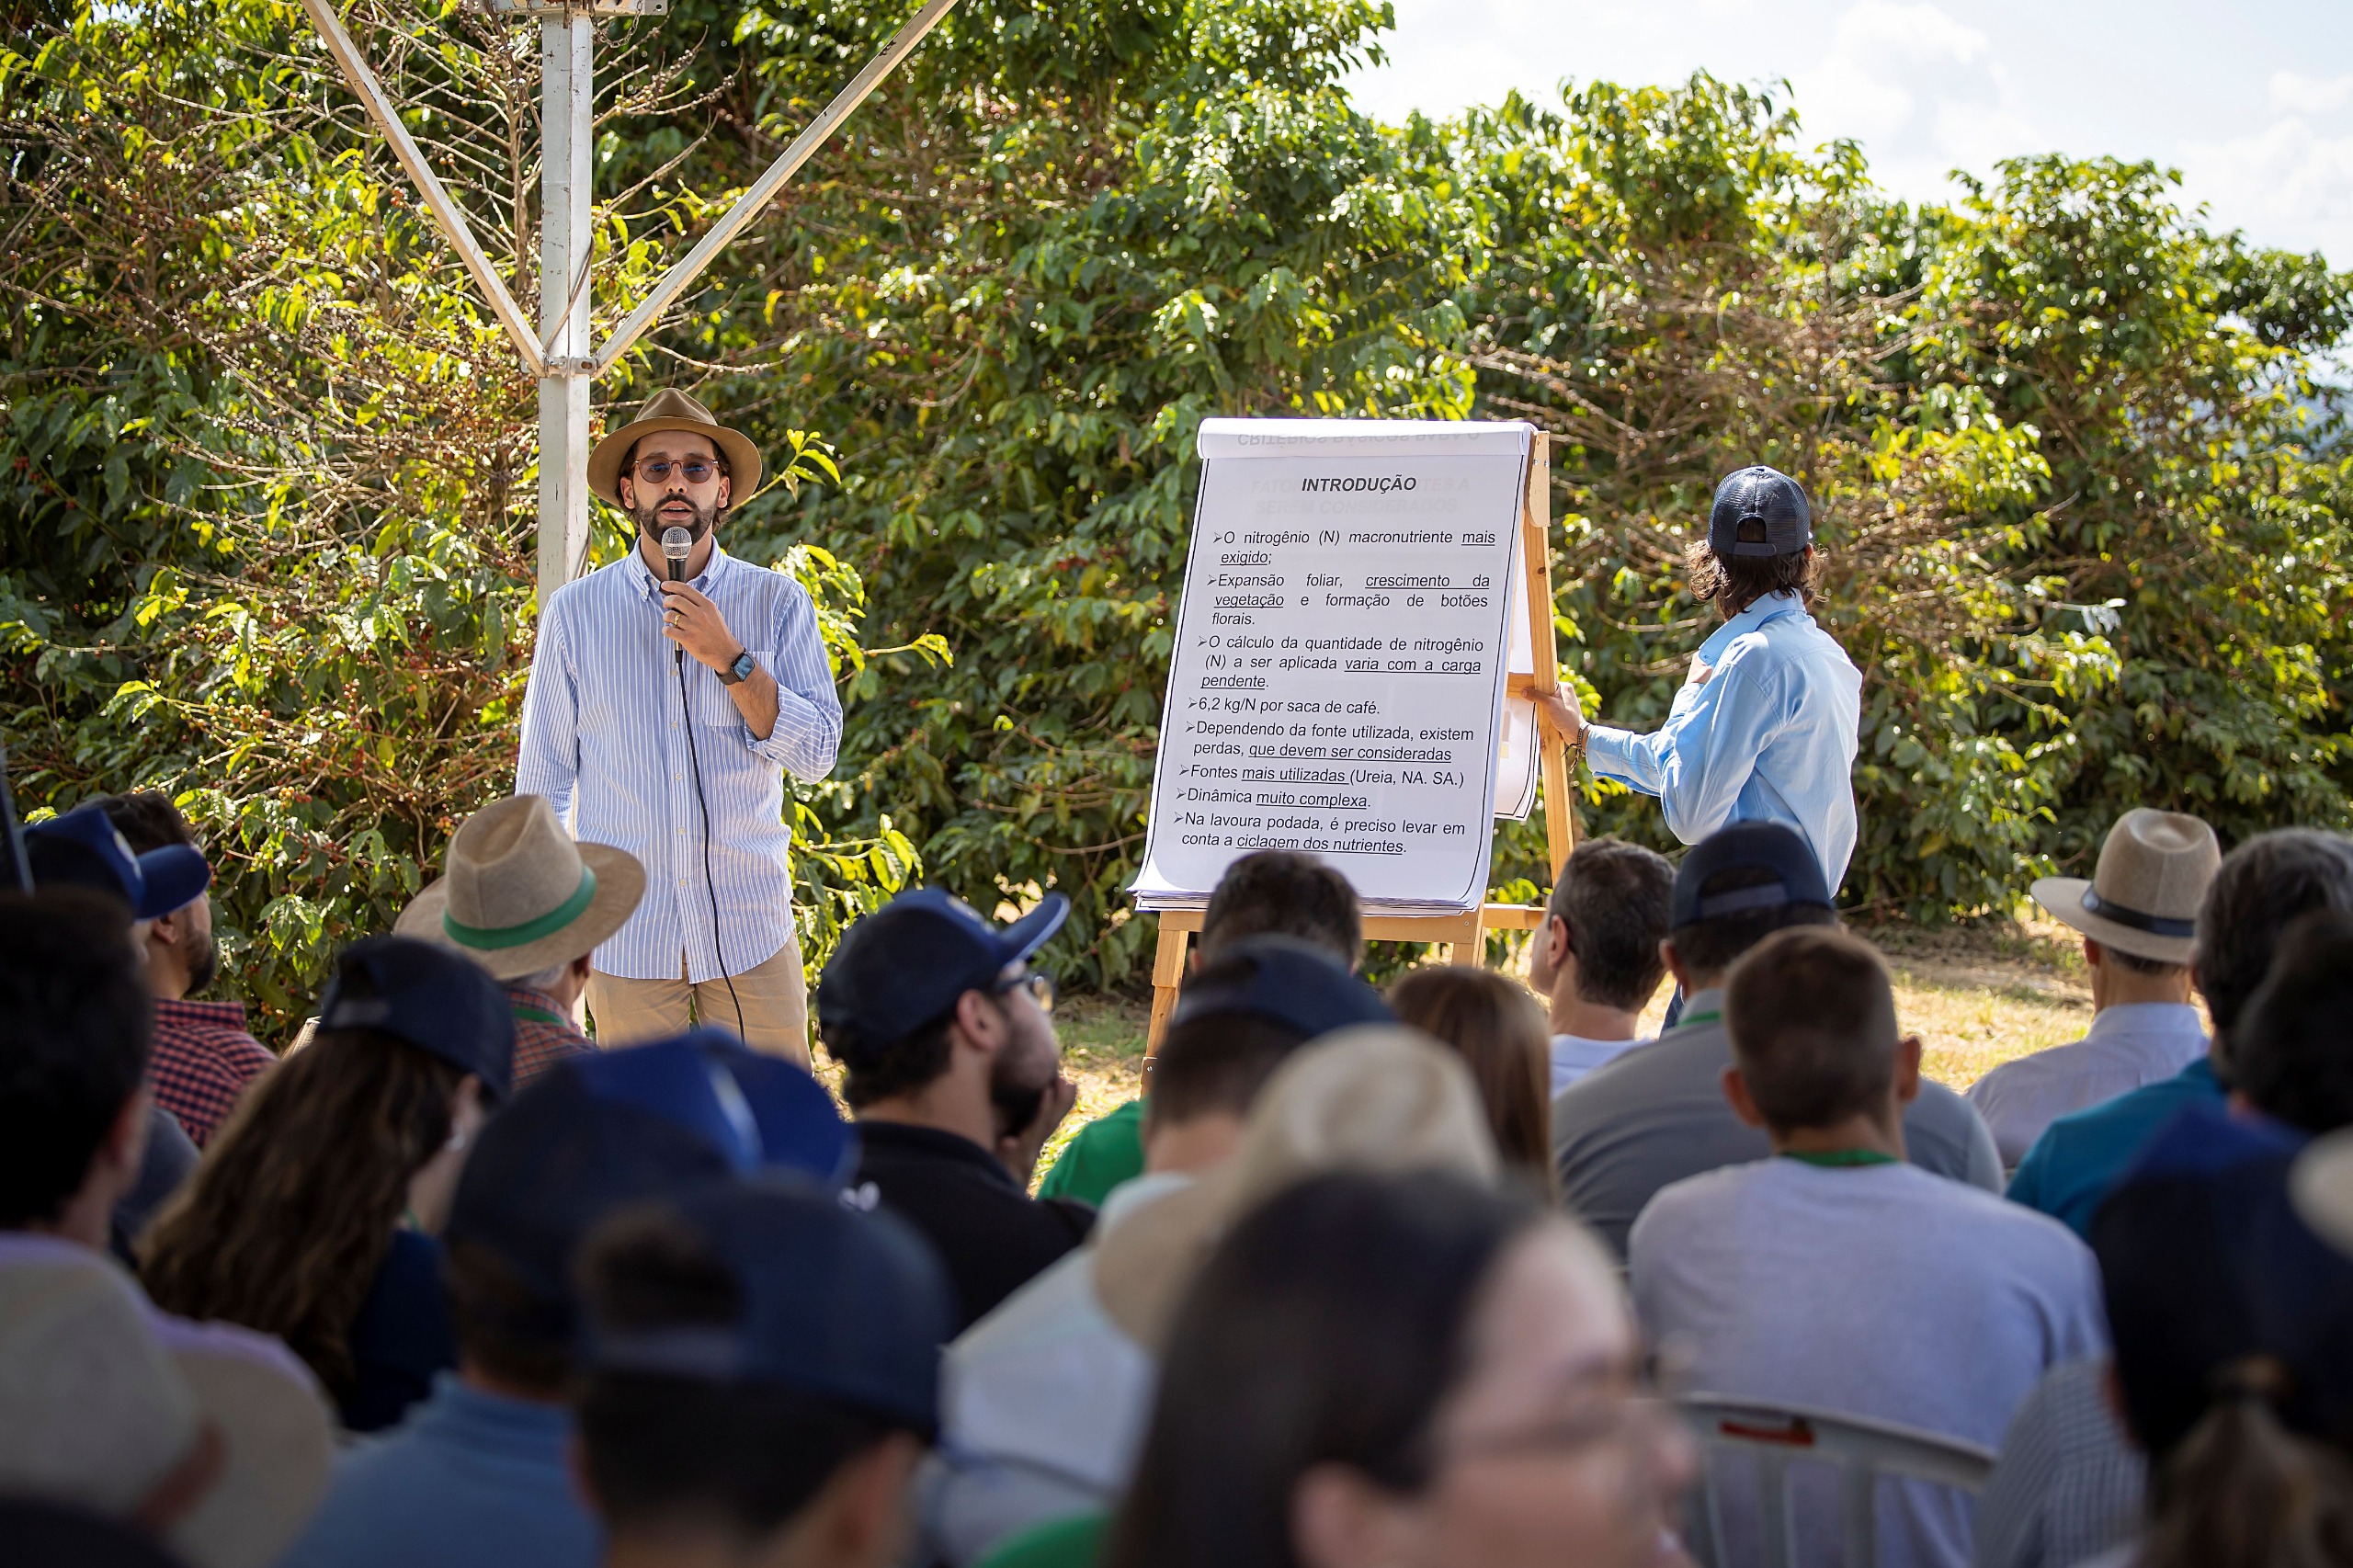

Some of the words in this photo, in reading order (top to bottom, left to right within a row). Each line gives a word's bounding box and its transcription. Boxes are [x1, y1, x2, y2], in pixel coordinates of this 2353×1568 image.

[1302, 474, 1417, 494] INTRODUÇÃO
[1224, 531, 1235, 544] O
[1245, 531, 1310, 547] nitrogênio
[1319, 530, 1340, 547] (N)
[1349, 530, 1453, 543] macronutriente
[1461, 530, 1495, 547] mais
[1220, 551, 1272, 567] exigido;
[1219, 574, 1285, 589] Expansão
[1307, 574, 1343, 589] foliar,
[1365, 574, 1450, 590] crescimento
[1472, 574, 1490, 590] da
[1214, 594, 1285, 609] vegetação
[1301, 597, 1309, 607] e
[1326, 594, 1391, 610] formação
[1407, 594, 1425, 608] de
[1441, 594, 1488, 608] botões
[1212, 612, 1255, 625] florais.
[1210, 636, 1221, 648] O
[1227, 636, 1275, 649] cálculo
[1281, 636, 1298, 649] da
[1305, 637, 1382, 653] quantidade
[1390, 638, 1407, 651] de
[1415, 638, 1483, 654] nitrogênio
[1206, 654, 1226, 671] (N)
[1234, 658, 1243, 668] a
[1250, 658, 1273, 668] ser
[1279, 656, 1337, 672] aplicada
[1344, 657, 1380, 674] varia
[1386, 661, 1417, 674] com
[1424, 661, 1434, 673] a
[1440, 662, 1482, 676] carga
[1200, 675, 1269, 691] pendente.
[1199, 698, 1221, 712] 6,2
[1224, 698, 1256, 714] kg/N
[1260, 702, 1283, 715] por
[1287, 702, 1321, 713] saca
[1325, 700, 1342, 713] de
[1347, 701, 1380, 715] café.
[1197, 722, 1285, 738] Dependendo
[1290, 723, 1307, 737] da
[1313, 724, 1347, 738] fonte
[1353, 725, 1414, 742] utilizada,
[1420, 727, 1474, 741] existem
[1194, 742, 1245, 757] perdas,
[1248, 745, 1276, 759] que
[1279, 744, 1327, 760] devem
[1330, 748, 1354, 760] ser
[1357, 746, 1452, 764] consideradas
[1191, 765, 1238, 778] Fontes
[1242, 767, 1277, 783] mais
[1279, 767, 1350, 786] utilizadas
[1349, 769, 1396, 786] (Ureia,
[1402, 771, 1427, 785] NA.
[1433, 772, 1464, 790] SA.)
[1188, 788, 1252, 803] Dinâmica
[1256, 791, 1296, 808] muito
[1299, 793, 1371, 811] complexa.
[1186, 812, 1205, 825] Na
[1211, 813, 1262, 828] lavoura
[1267, 816, 1324, 832] podada,
[1330, 817, 1339, 831] é
[1345, 819, 1396, 835] preciso
[1403, 820, 1438, 835] levar
[1443, 824, 1465, 835] em
[1182, 834, 1220, 846] conta
[1224, 836, 1233, 846] a
[1235, 835, 1299, 852] ciclagem
[1302, 836, 1329, 852] dos
[1333, 838, 1406, 856] nutrientes.
